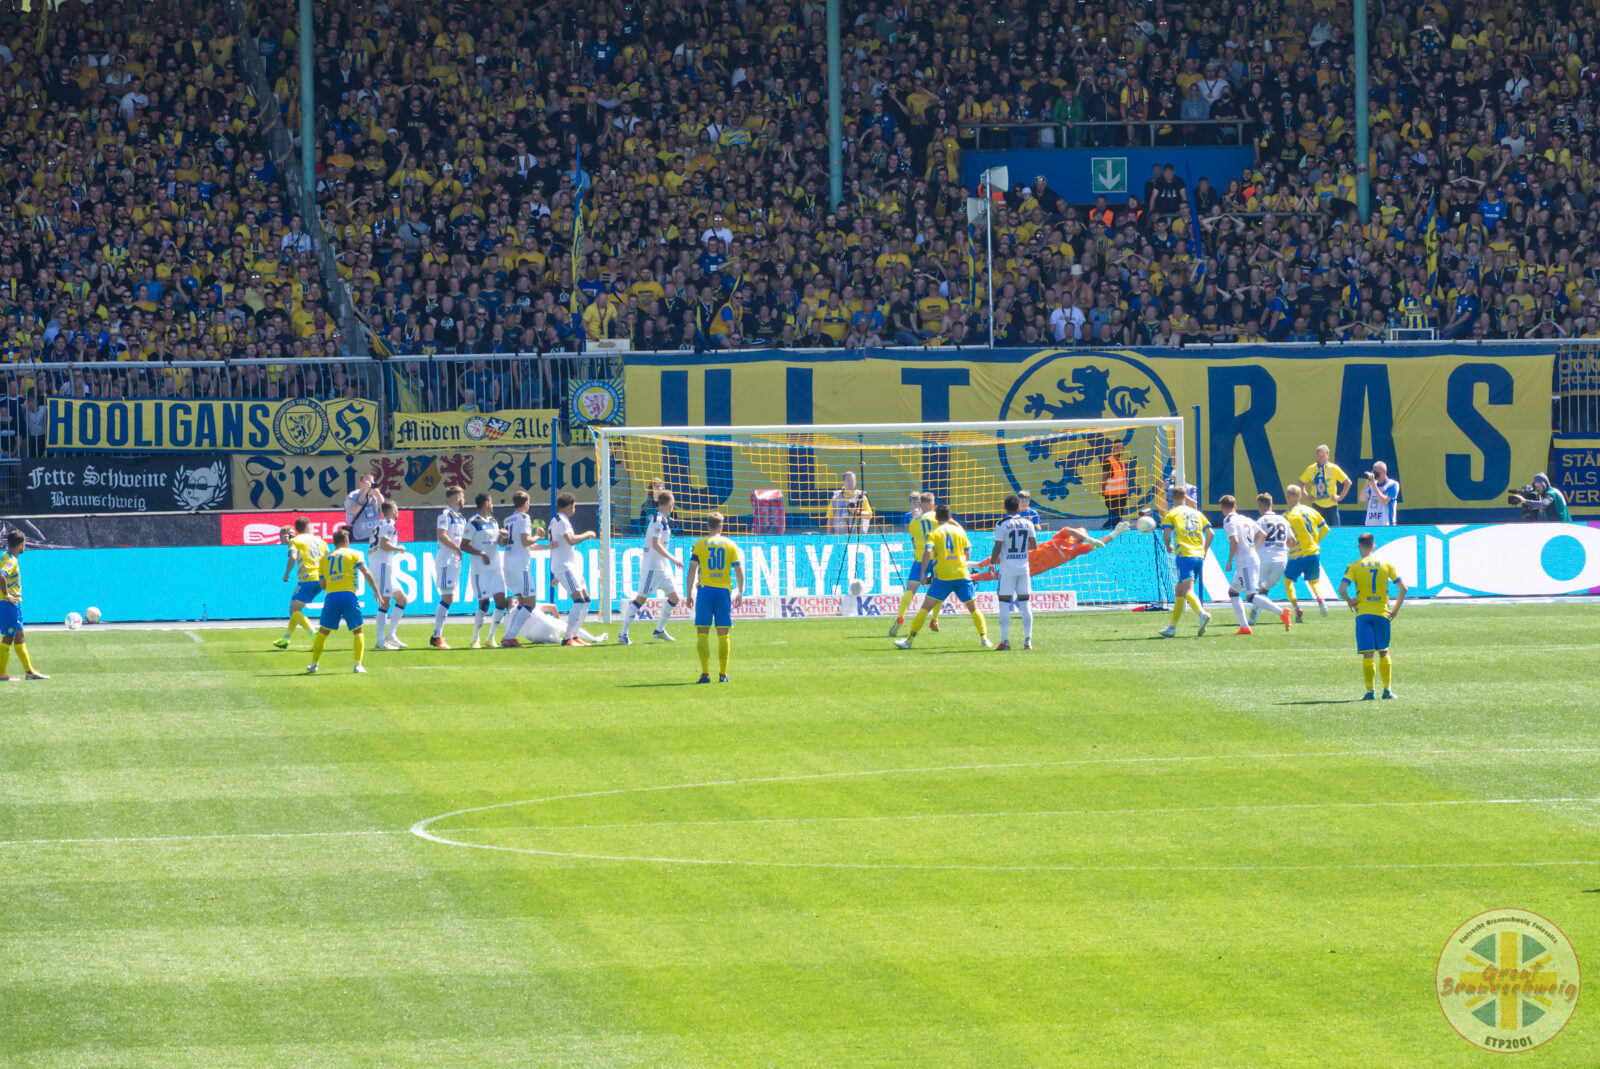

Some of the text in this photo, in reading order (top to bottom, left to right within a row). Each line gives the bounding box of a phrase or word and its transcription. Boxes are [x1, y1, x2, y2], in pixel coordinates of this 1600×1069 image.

[49, 400, 270, 449] HOOLIGANS
[397, 419, 460, 444] Müden
[512, 417, 553, 440] Alle
[1562, 451, 1600, 467] STÄ
[27, 465, 168, 490] Fette Schweine
[245, 454, 358, 510] Frei
[1563, 472, 1597, 486] ALS
[51, 491, 147, 512] Braunschweig
[945, 532, 954, 554] 4
[1007, 529, 1029, 553] 17
[1265, 522, 1287, 543] 28
[707, 547, 725, 571] 30
[1369, 568, 1379, 594] 7
